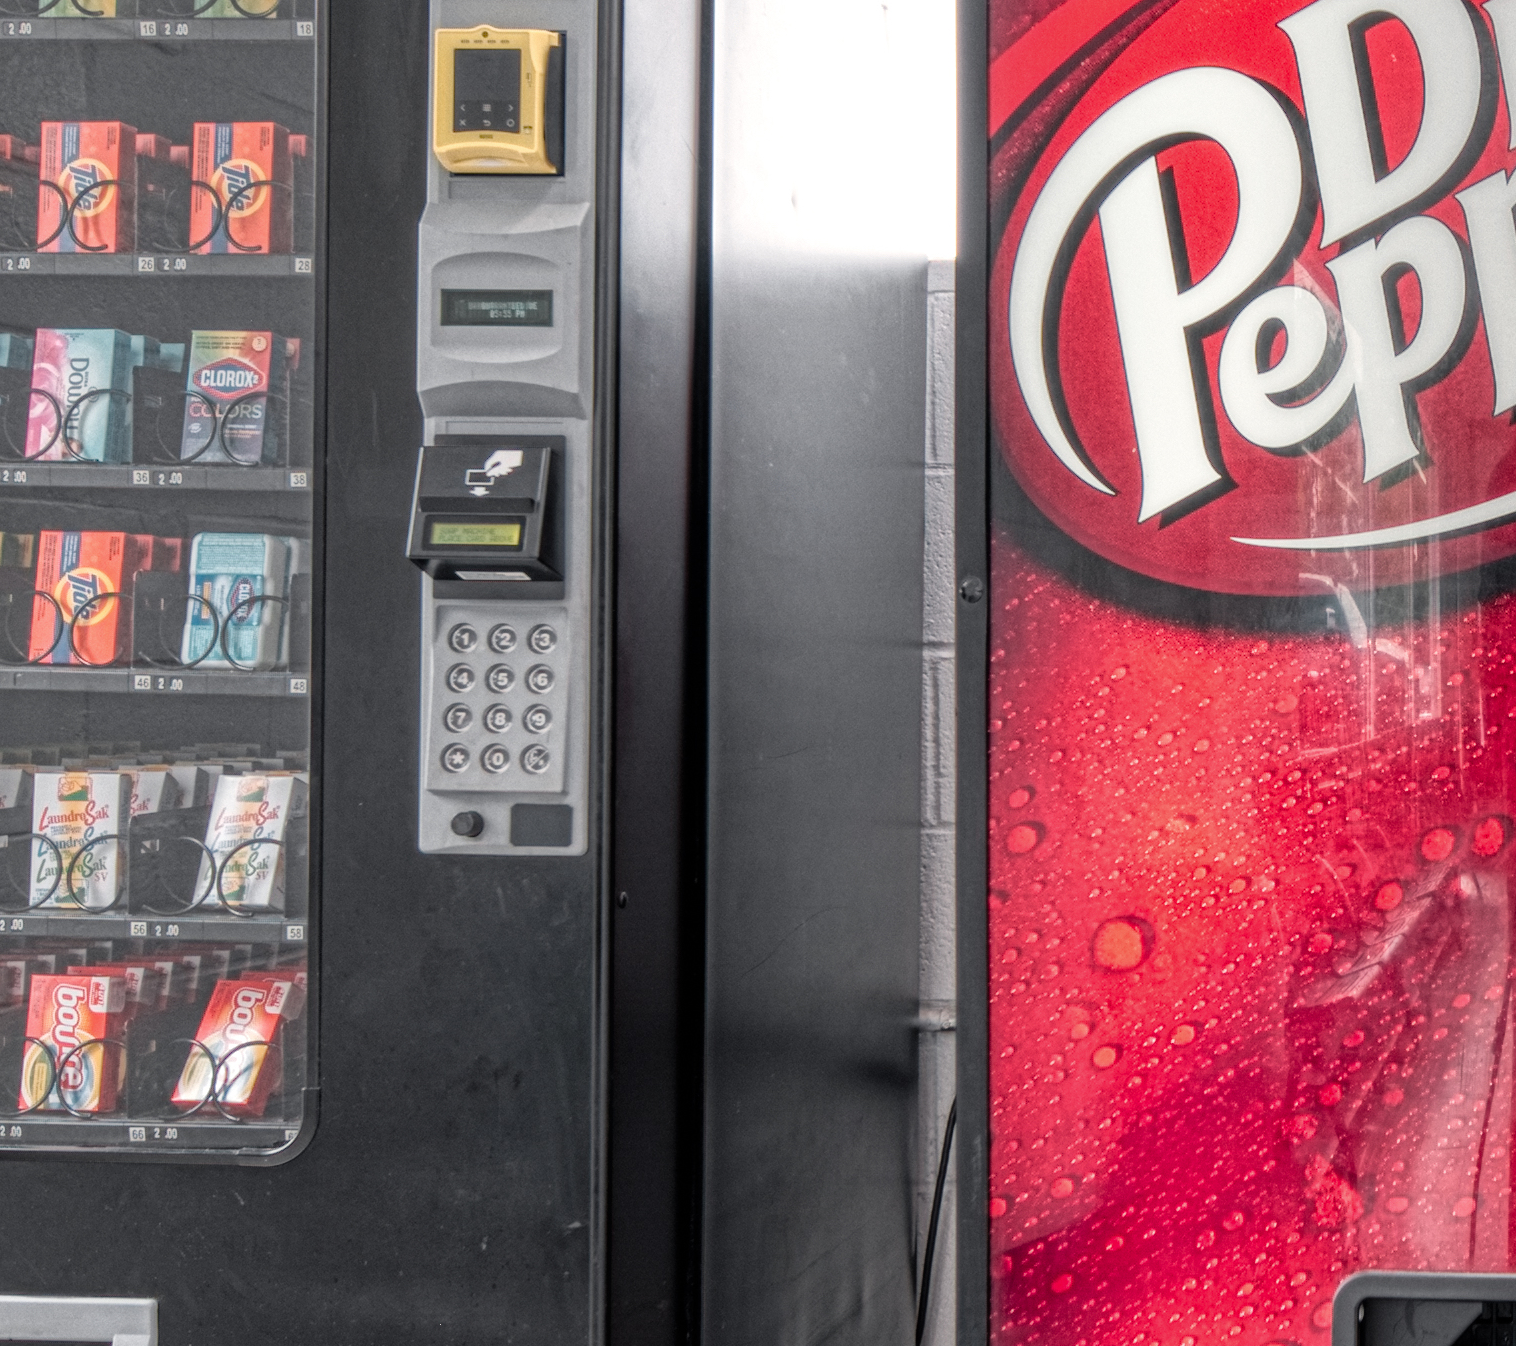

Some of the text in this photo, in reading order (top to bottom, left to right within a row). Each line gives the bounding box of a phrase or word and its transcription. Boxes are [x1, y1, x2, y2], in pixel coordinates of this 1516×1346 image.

[143, 24, 154, 35] 16
[66, 163, 101, 211] Tide
[220, 162, 255, 212] Tide
[141, 259, 153, 270] 26
[293, 474, 305, 485] 38
[66, 571, 101, 621] Tide
[461, 633, 550, 646] 1 2 3
[137, 677, 149, 688] 46
[457, 672, 548, 686] 4 5 6
[454, 712, 546, 725] 7 8 9
[492, 753, 503, 765] 0
[290, 927, 302, 938] 58
[132, 1129, 144, 1140] 66
